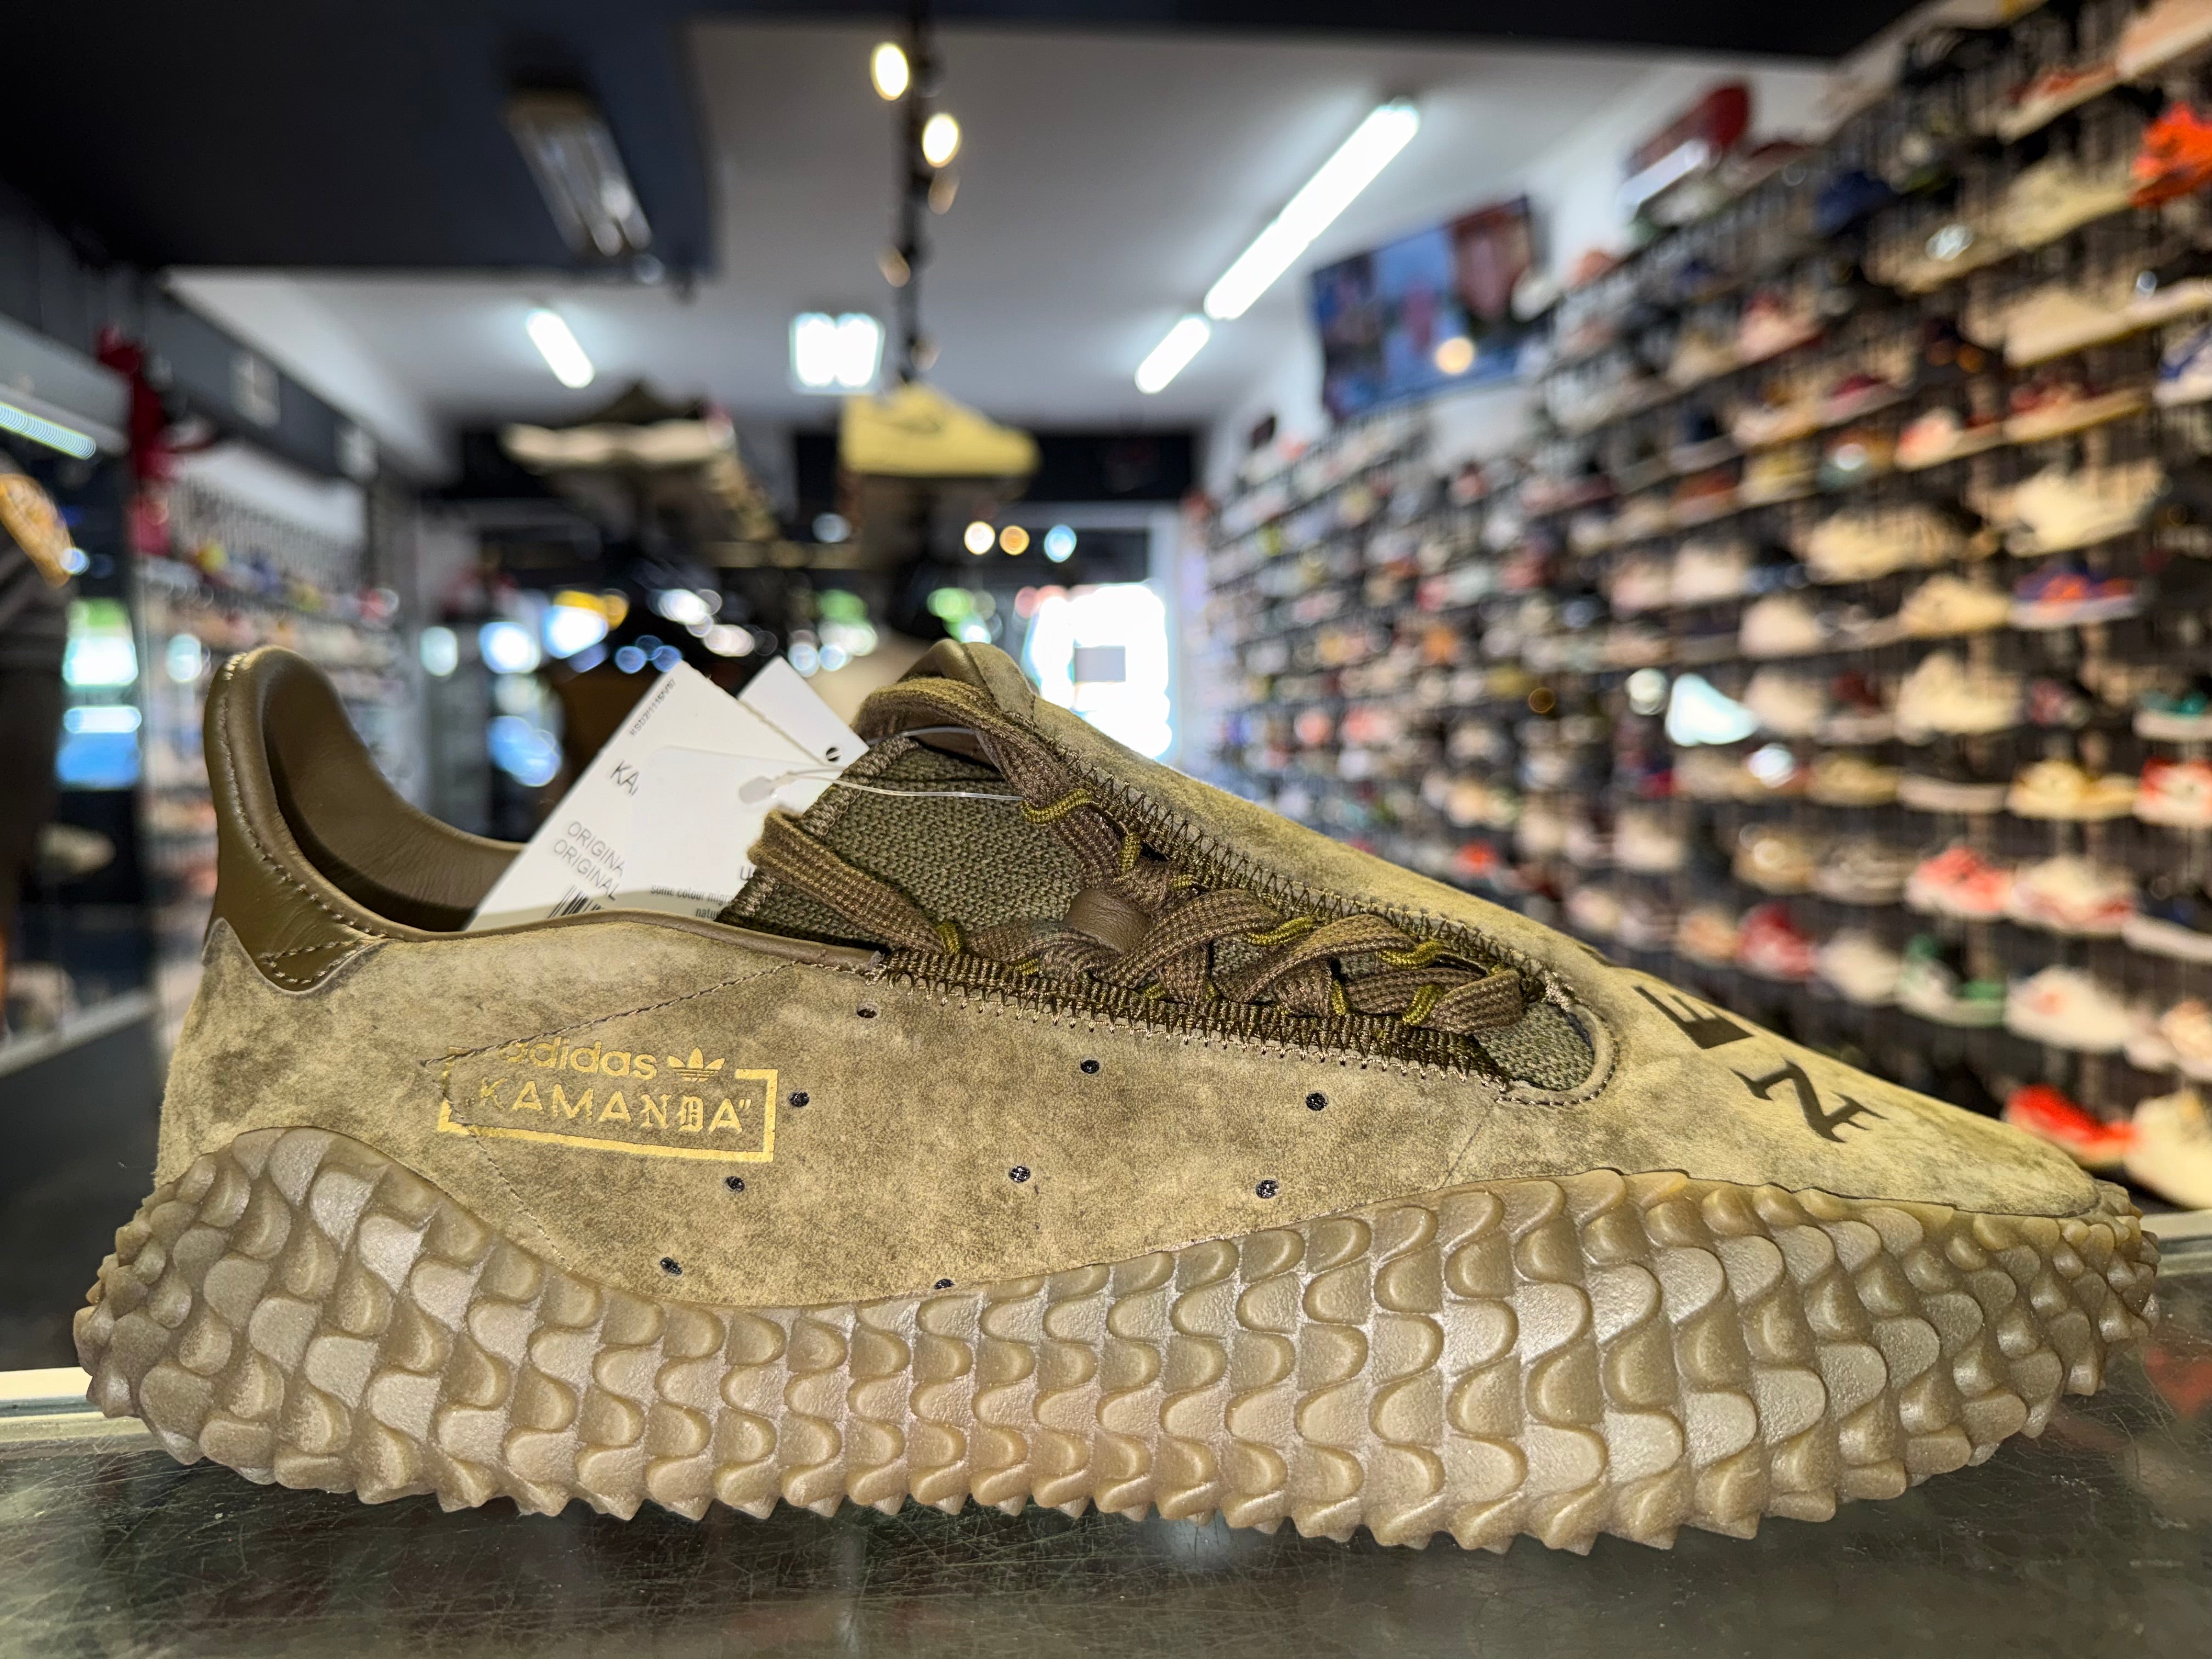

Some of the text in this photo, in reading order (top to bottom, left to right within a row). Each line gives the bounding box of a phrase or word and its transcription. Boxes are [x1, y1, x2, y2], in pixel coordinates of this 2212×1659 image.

[651, 884, 675, 896] some
[677, 887, 704, 901] colour
[500, 1036, 658, 1081] adidas
